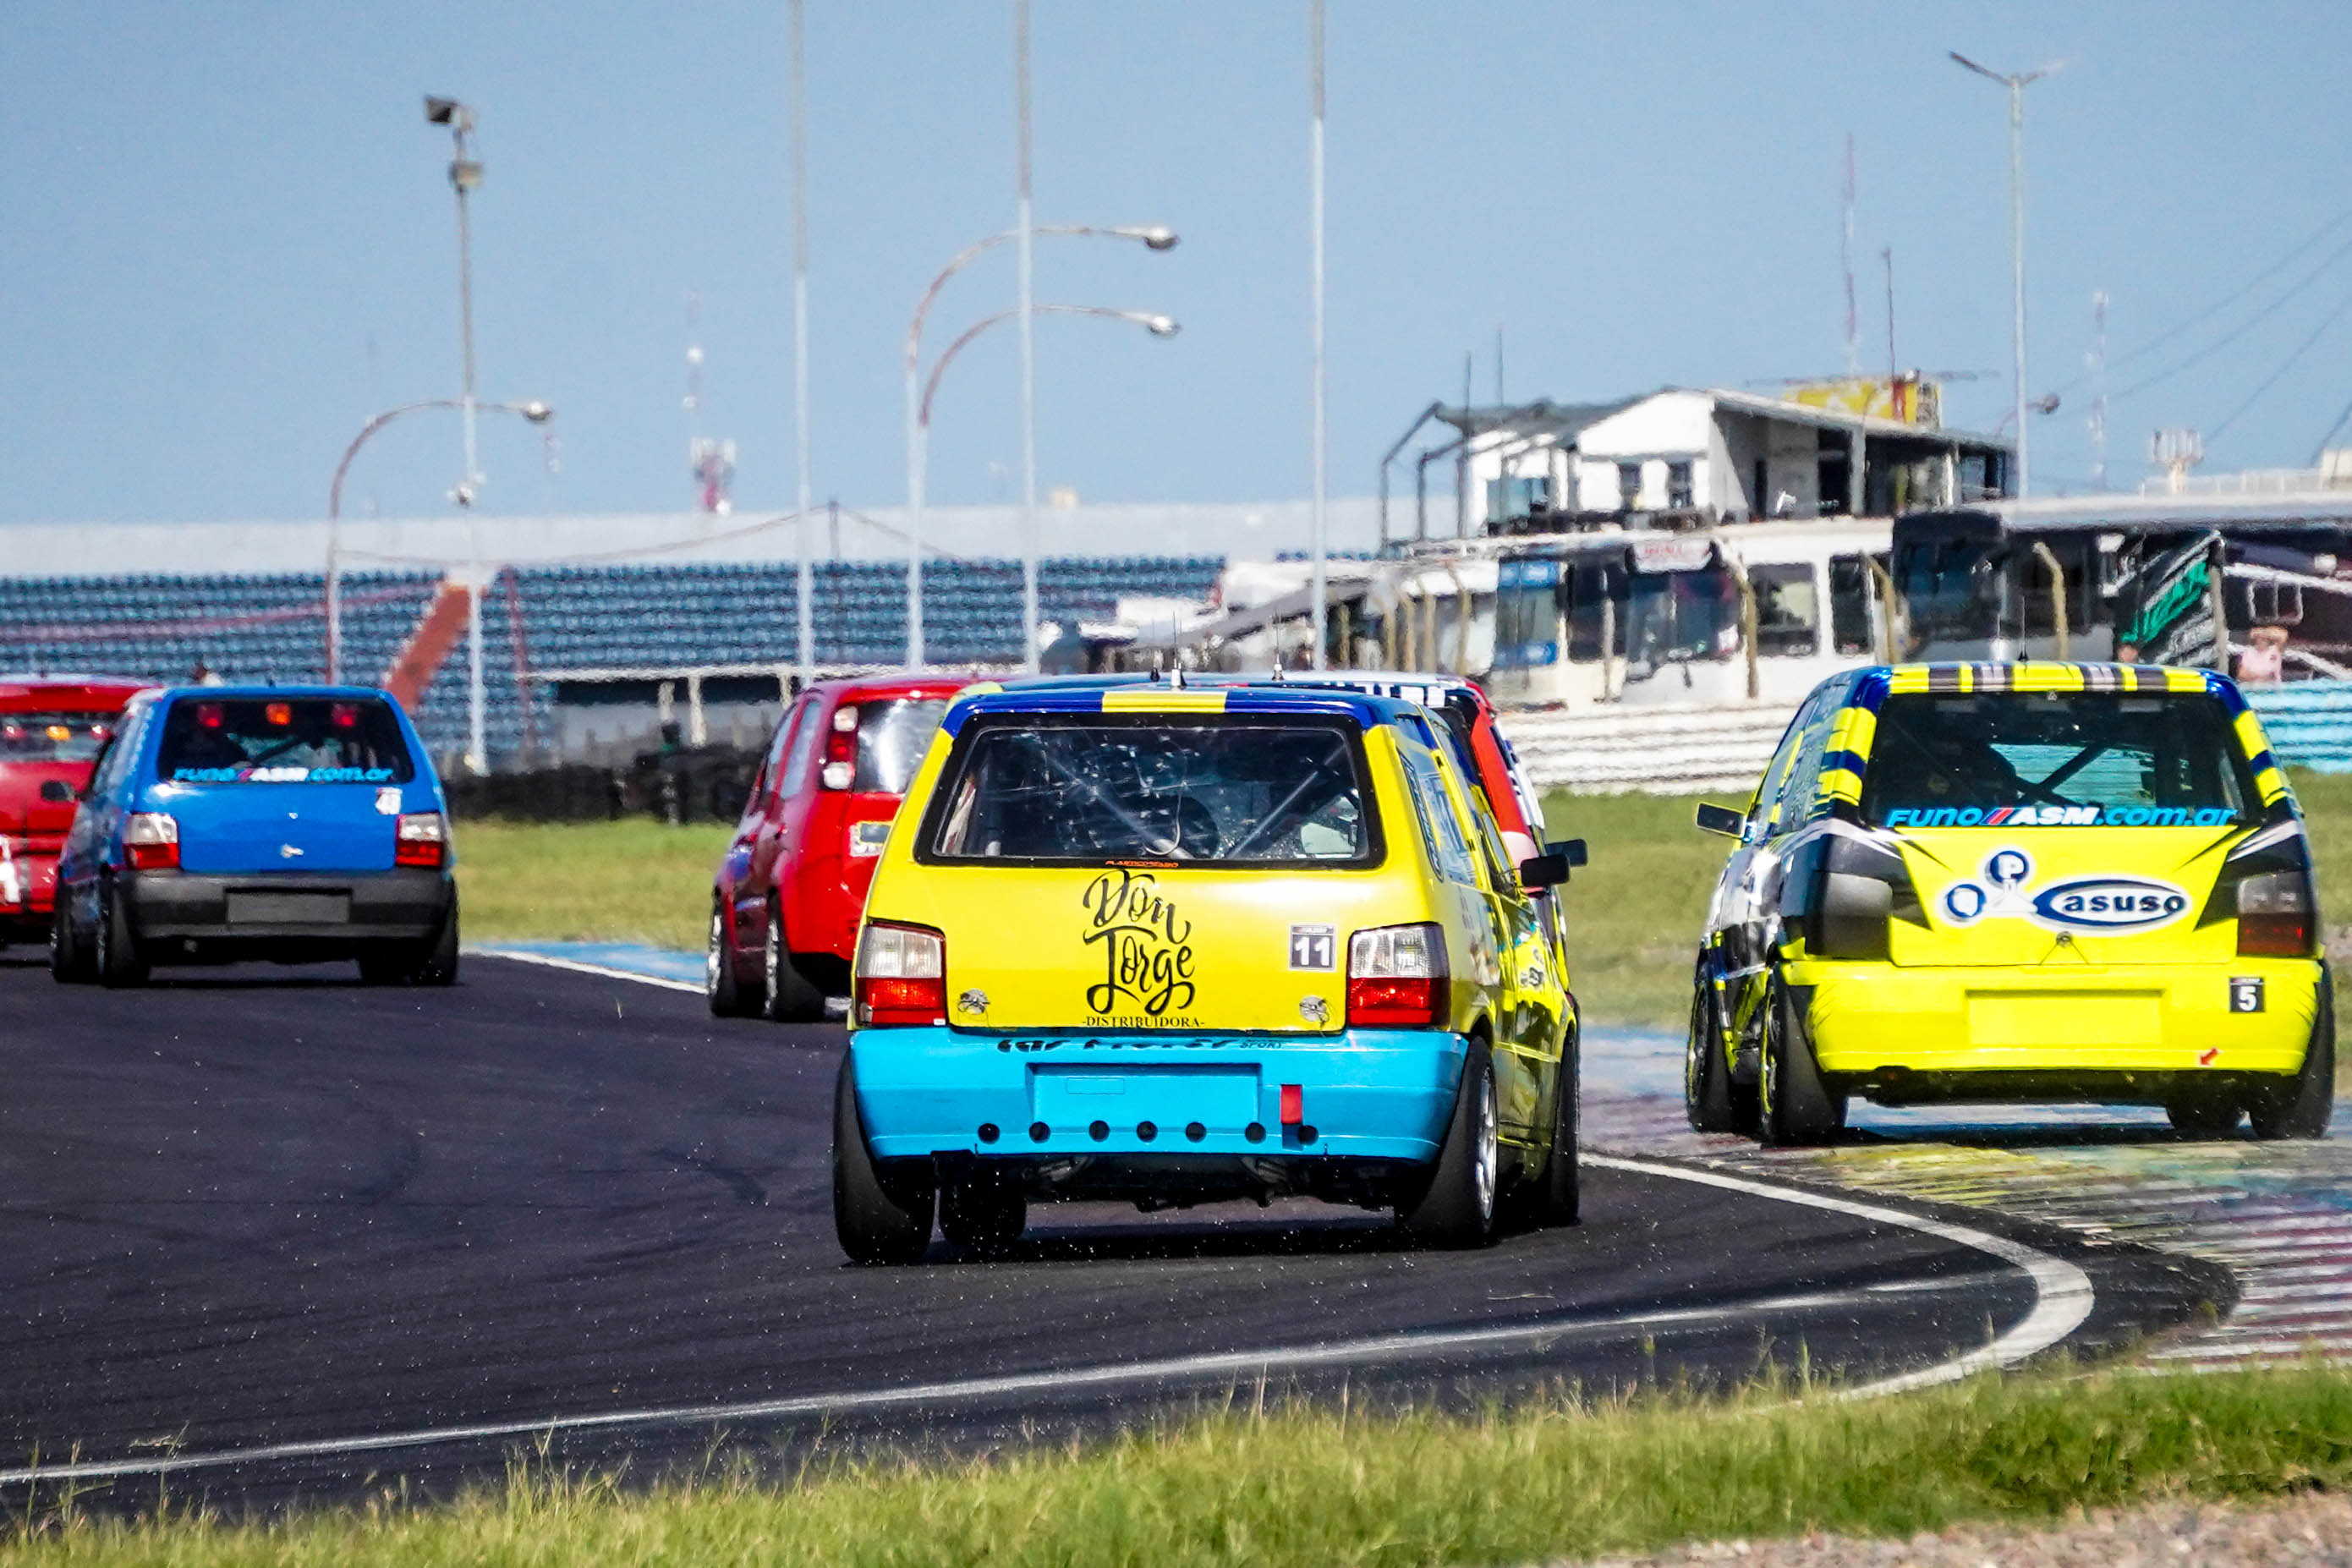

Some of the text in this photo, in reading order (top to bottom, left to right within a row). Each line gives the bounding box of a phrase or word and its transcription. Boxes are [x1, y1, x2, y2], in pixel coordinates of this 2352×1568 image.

[1083, 869, 1192, 945] Don
[1083, 925, 1196, 1016] Jorge
[1295, 935, 1330, 966] 11
[2238, 985, 2257, 1012] 5
